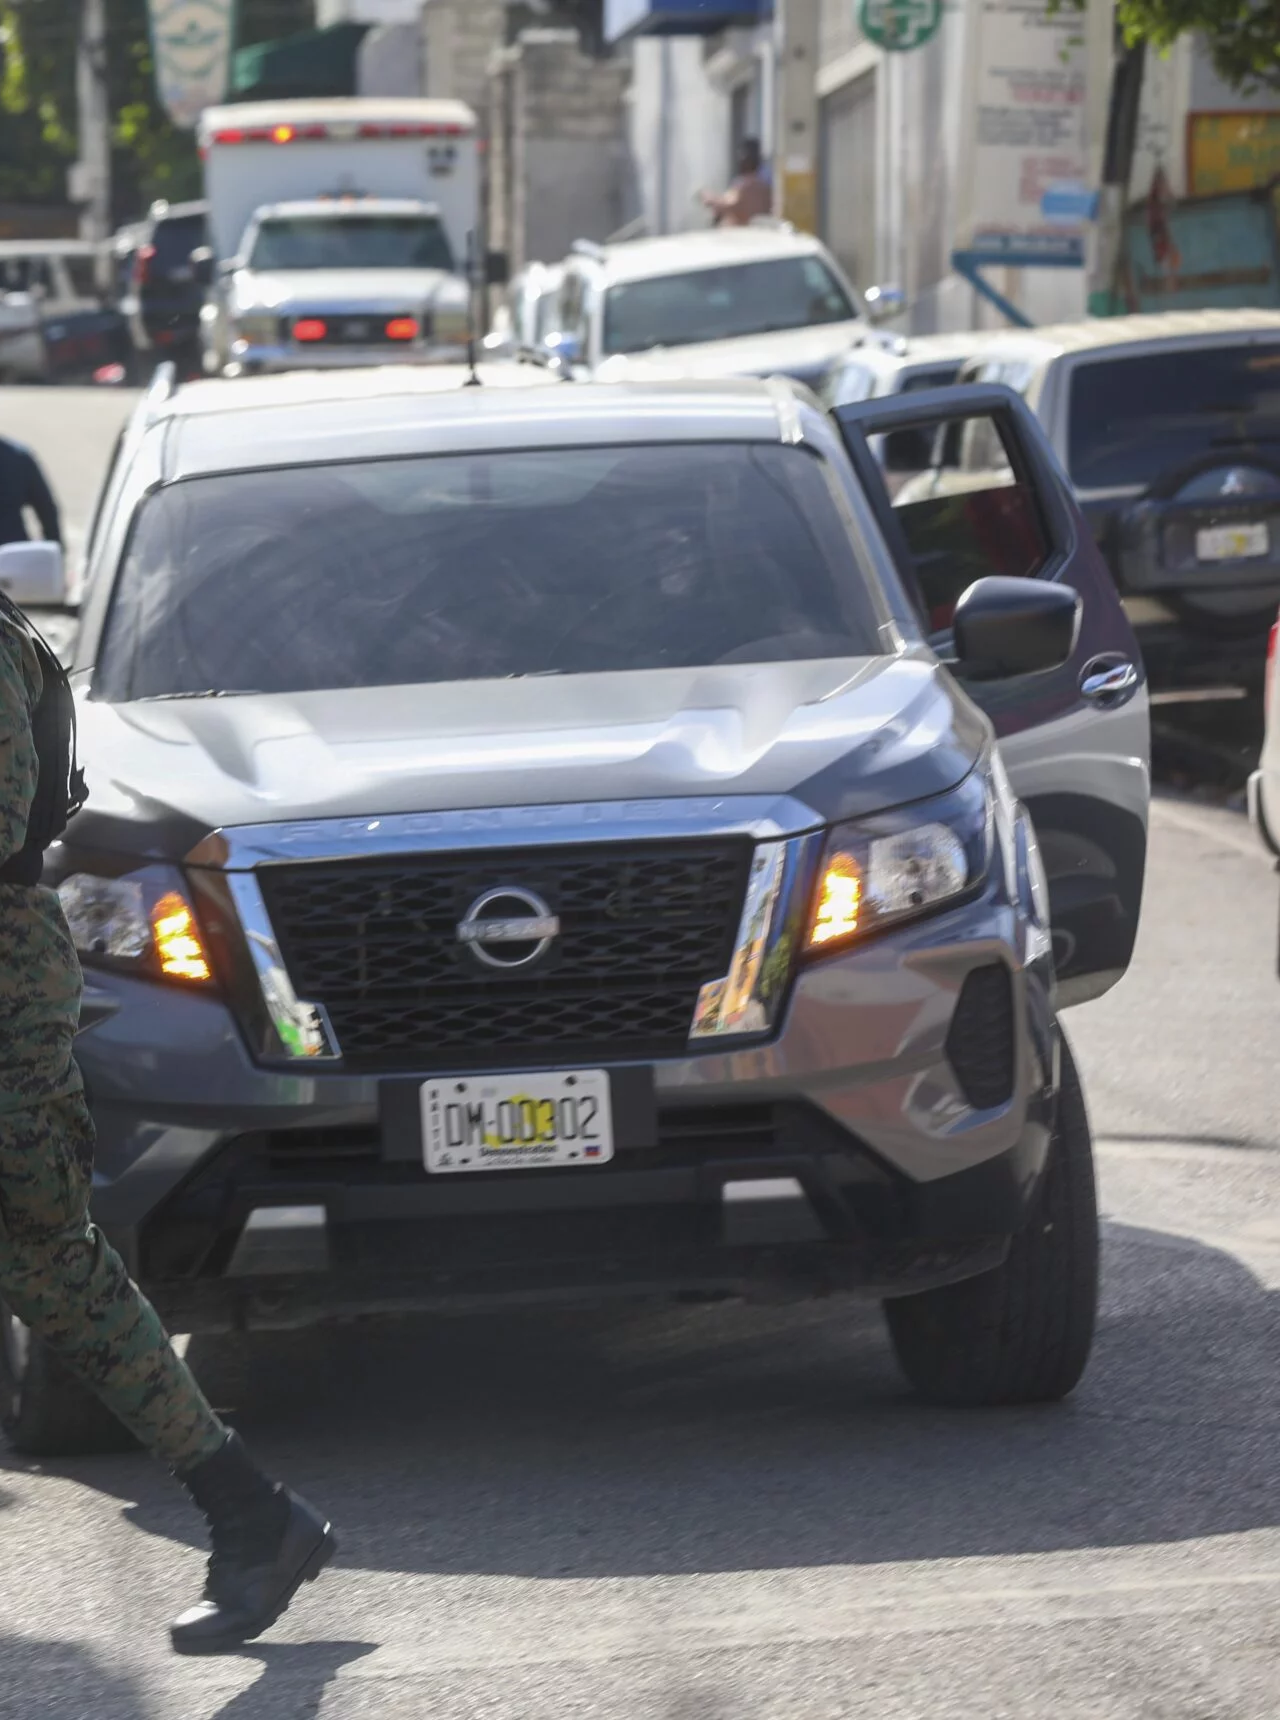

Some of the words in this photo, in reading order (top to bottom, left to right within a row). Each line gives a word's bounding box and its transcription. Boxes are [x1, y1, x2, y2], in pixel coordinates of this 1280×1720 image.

[278, 801, 725, 841] FRONTIER
[459, 921, 557, 939] NISSAN
[445, 1095, 600, 1146] DM-00302
